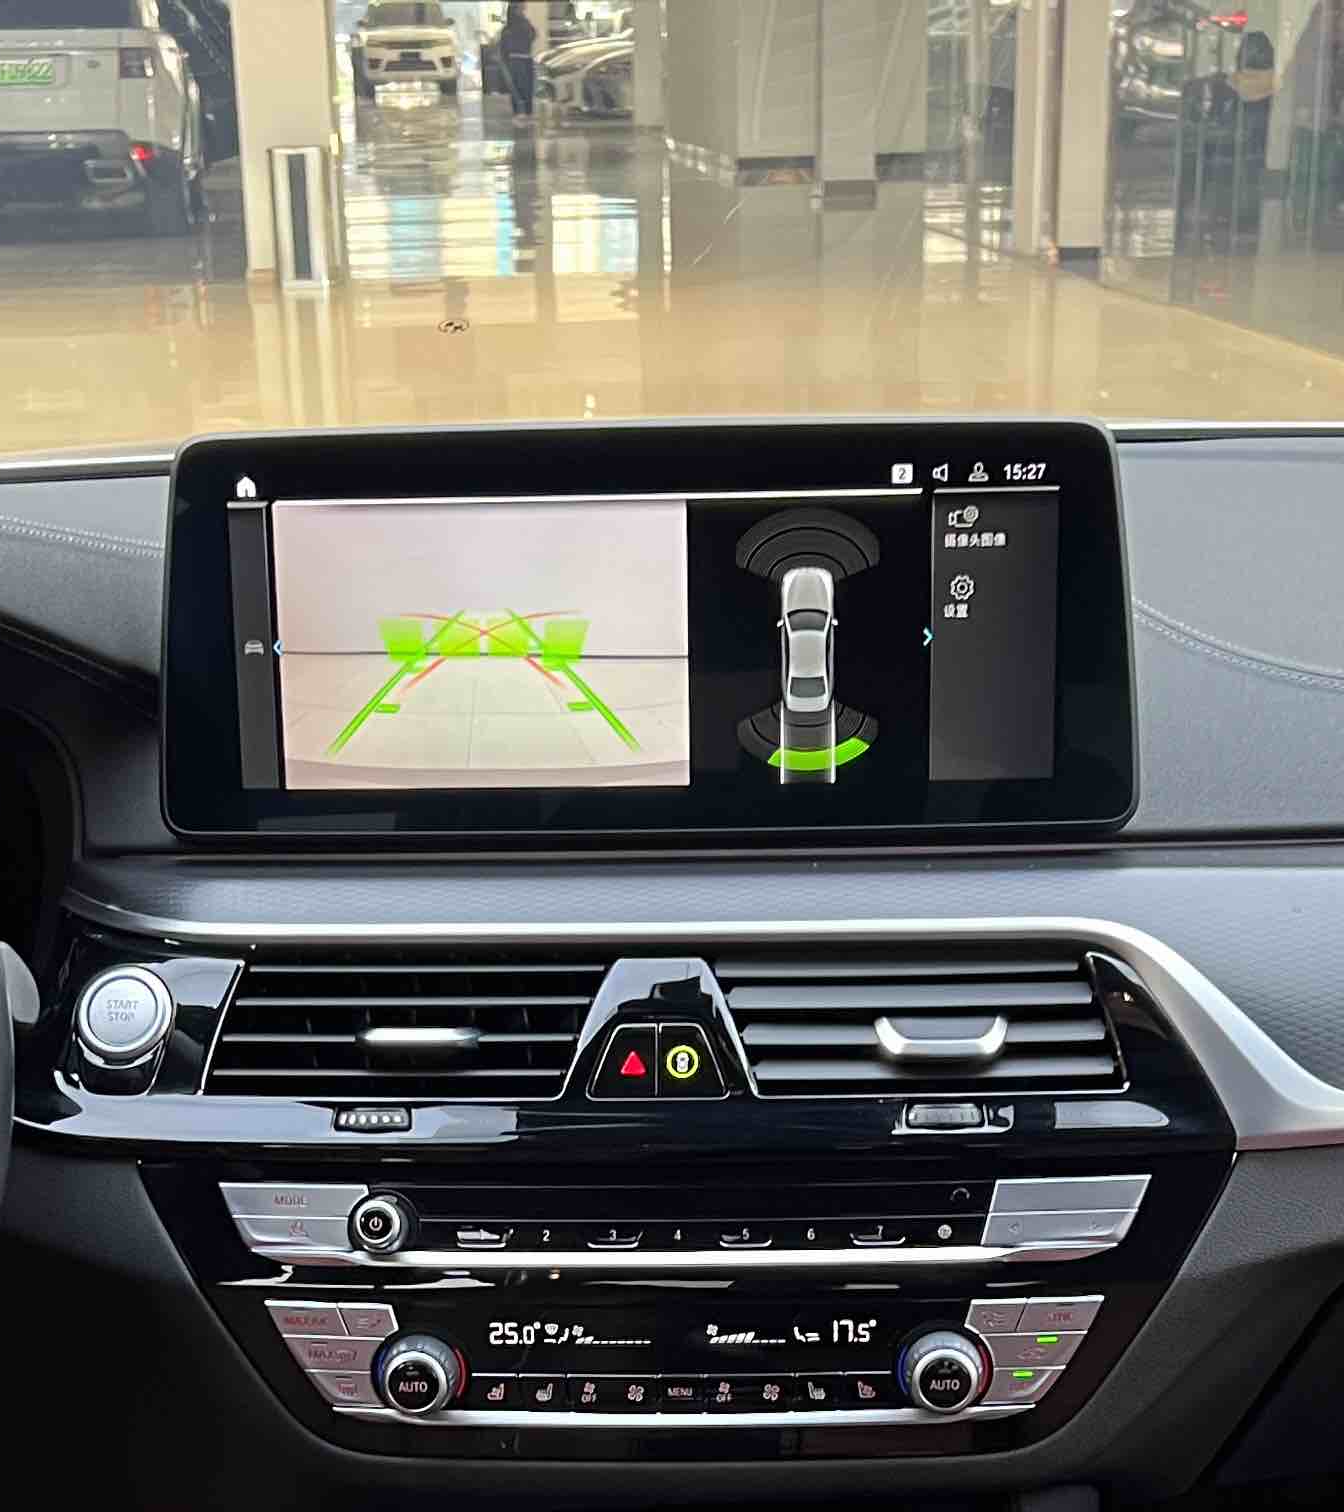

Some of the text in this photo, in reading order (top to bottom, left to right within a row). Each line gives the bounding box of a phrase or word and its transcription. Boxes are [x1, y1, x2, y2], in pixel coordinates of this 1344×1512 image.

[1003, 463, 1047, 480] 15:27
[105, 1000, 140, 1009] START
[107, 1012, 136, 1022] STOP
[541, 1229, 551, 1243] 2
[608, 1228, 618, 1242] 3
[672, 1228, 682, 1241] 4
[741, 1228, 751, 1242] 5
[806, 1227, 816, 1241] 6
[876, 1225, 885, 1239] 7
[398, 1382, 428, 1393] AUTO
[667, 1386, 694, 1397] MENU
[929, 1380, 961, 1392] AUTO
